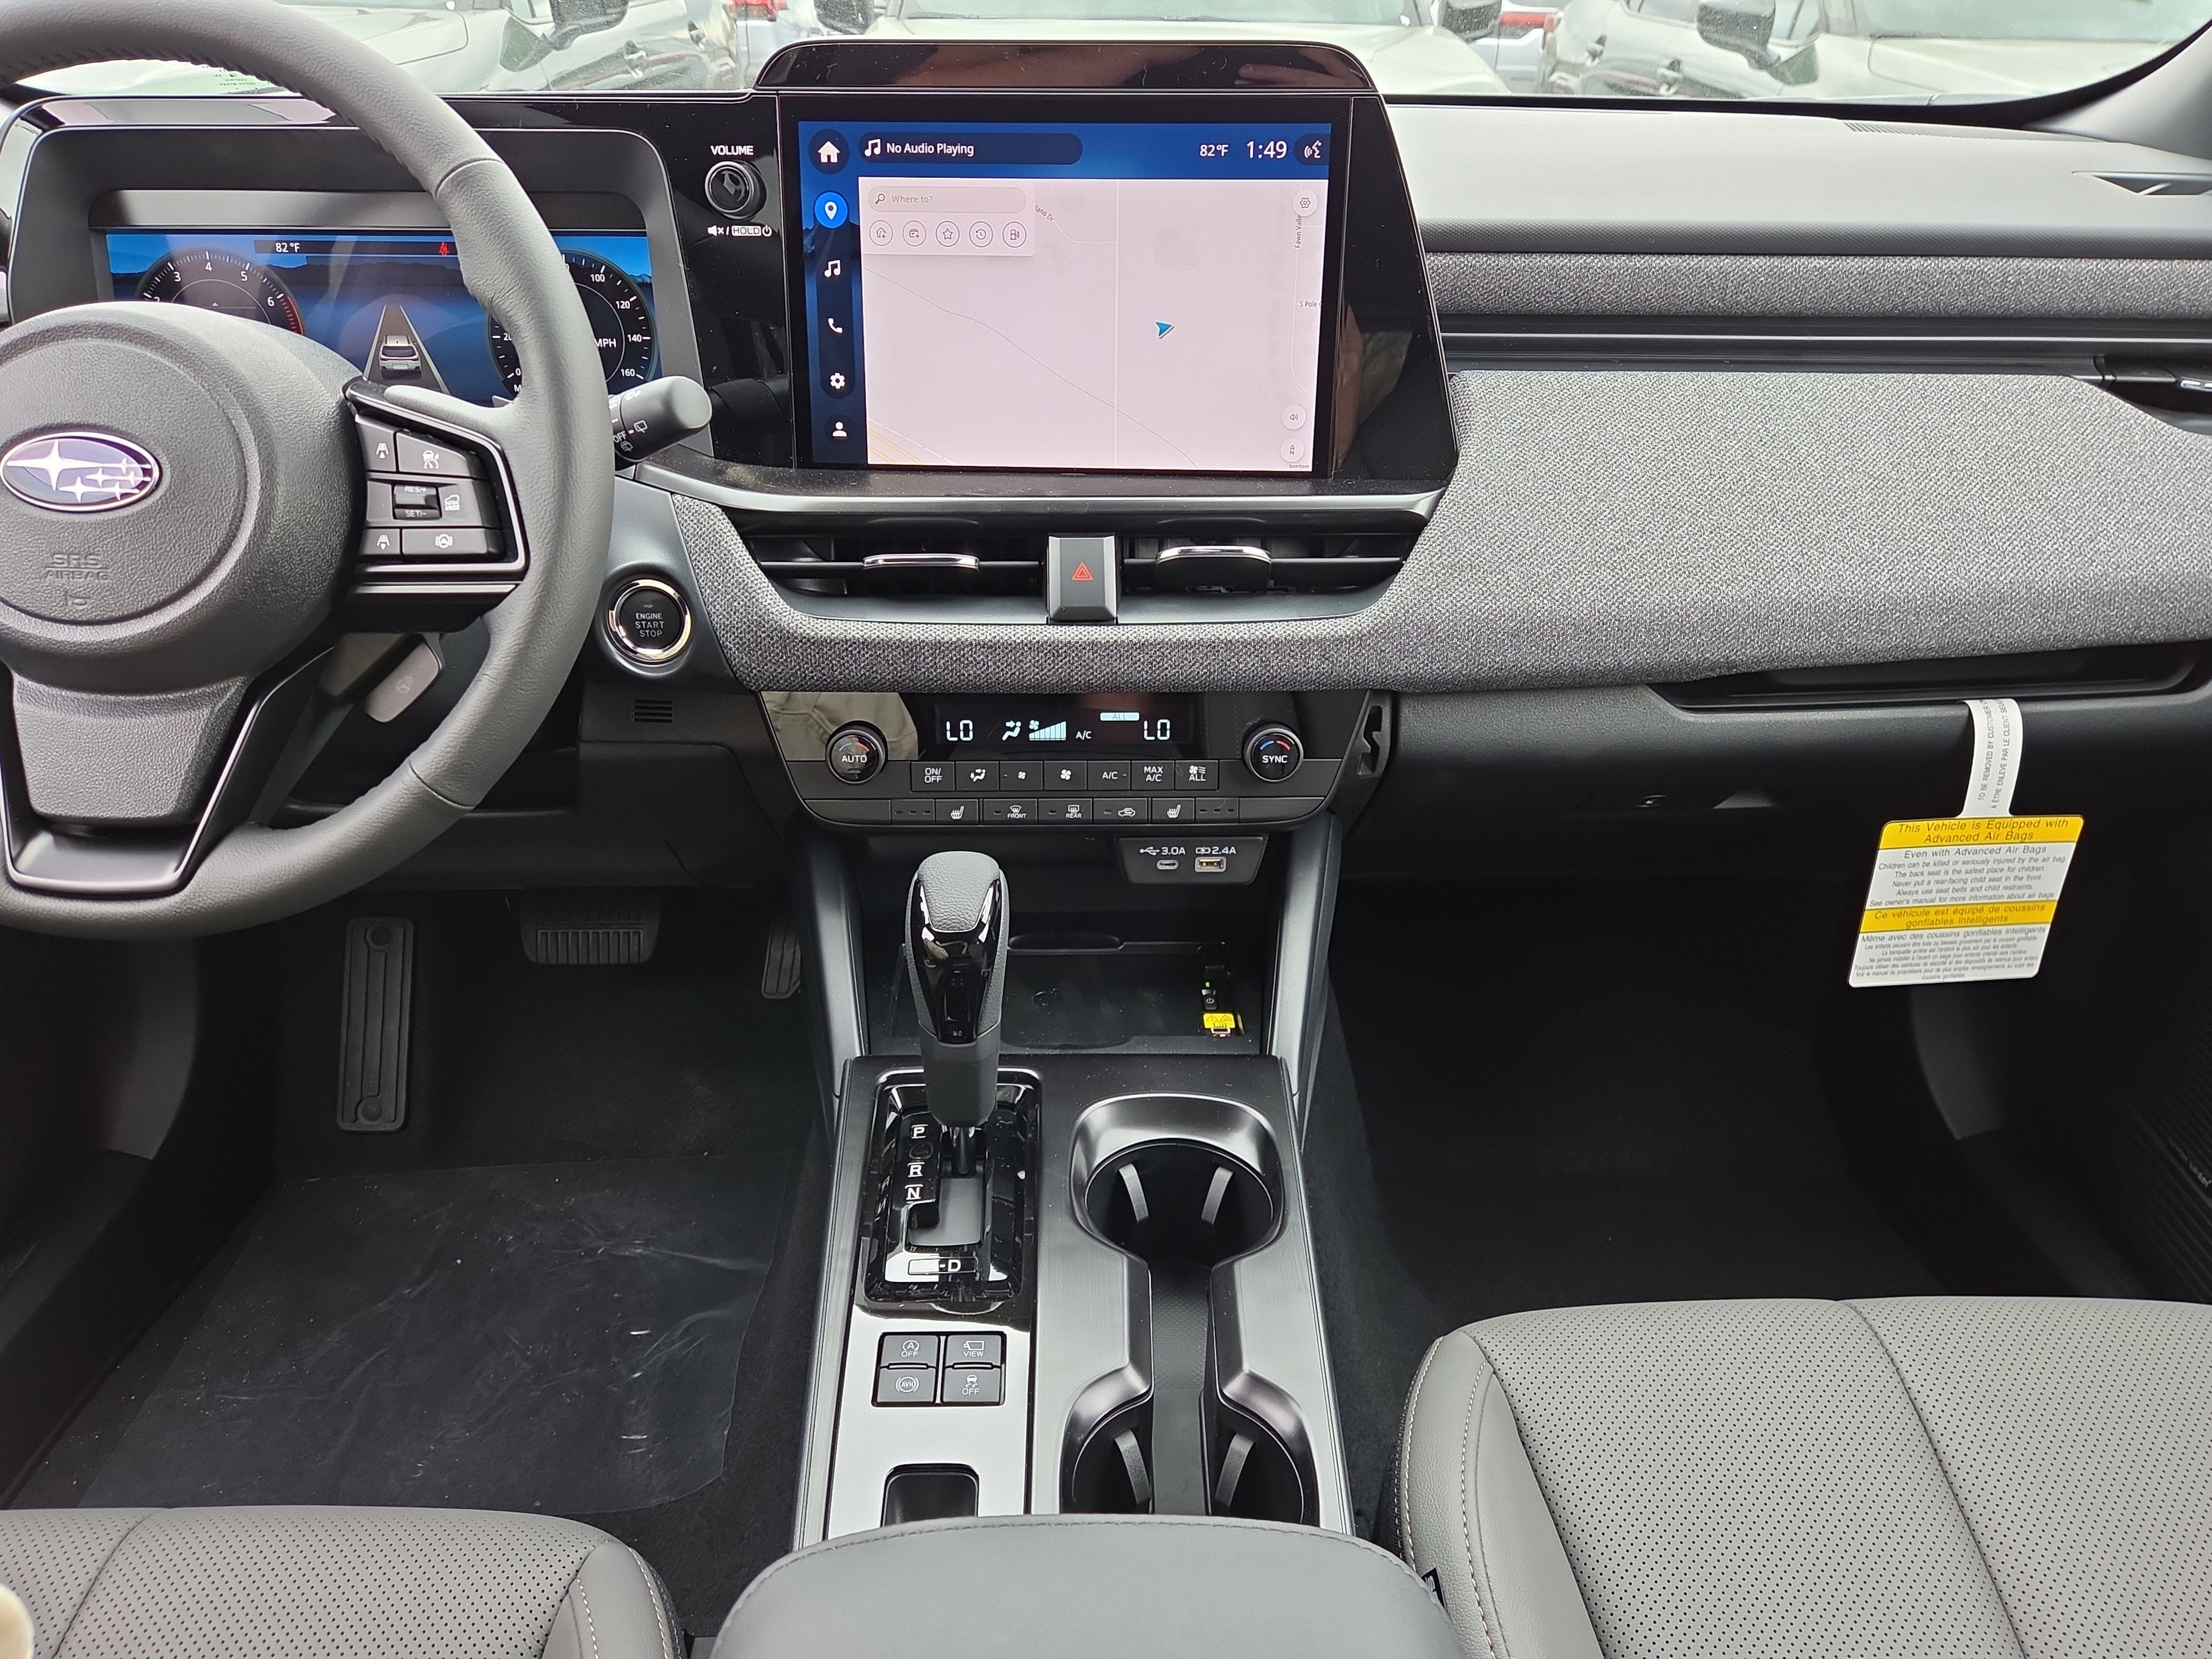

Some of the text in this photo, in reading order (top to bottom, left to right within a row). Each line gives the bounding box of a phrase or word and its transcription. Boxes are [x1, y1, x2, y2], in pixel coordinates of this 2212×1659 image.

[710, 145, 754, 155] VOLUME
[886, 143, 975, 157] No Audio Playing
[1199, 144, 1229, 157] 82°F
[1247, 140, 1287, 158] 1:49
[891, 194, 934, 203] Where to?
[205, 262, 213, 272] 4
[173, 272, 181, 282] 3
[241, 271, 248, 281] 5
[590, 274, 605, 282] 100
[267, 297, 275, 306] 6
[616, 300, 630, 309] 120
[594, 338, 616, 348] MPH
[627, 334, 642, 342] 140
[515, 368, 521, 376] 0
[621, 369, 635, 377] 160
[613, 430, 626, 443] OFF
[53, 554, 102, 568] SRS
[46, 570, 110, 581] AIRBAG
[635, 621, 665, 629] START
[946, 719, 973, 741] LO
[1143, 719, 1171, 741] LO
[1076, 730, 1092, 741] A/C
[841, 755, 867, 763] AUTO
[1262, 755, 1288, 763] SYNC
[925, 767, 941, 775] ON/
[1102, 771, 1118, 780] A/C
[924, 776, 943, 784] OFF
[1146, 774, 1162, 782] A/C
[1188, 774, 1207, 782] ALL
[1899, 819, 2068, 833] This Vehicle is Equipped with
[1924, 831, 2034, 843] Advanced Air Bags
[1161, 847, 1186, 855] 3.0A
[1212, 846, 1237, 855] 2.4A
[1904, 850, 1927, 859] Even
[1932, 848, 1950, 857] with
[1954, 846, 2002, 856] Advanced
[2022, 845, 2047, 855] Bags
[1878, 862, 1905, 870] Children
[1896, 889, 1919, 897] Always
[1874, 911, 1887, 919] Ce
[1892, 909, 1930, 918] véhicule
[1934, 908, 1949, 916] est
[1988, 905, 2000, 914] de
[2004, 904, 2045, 912] coussins
[1906, 915, 2008, 928] gonflables intelligents
[1861, 934, 1885, 943] Même
[1888, 933, 1907, 941] avec
[913, 1126, 925, 1137] P
[909, 1164, 922, 1176] R
[906, 1187, 921, 1198] N
[962, 1387, 980, 1396] OFF
